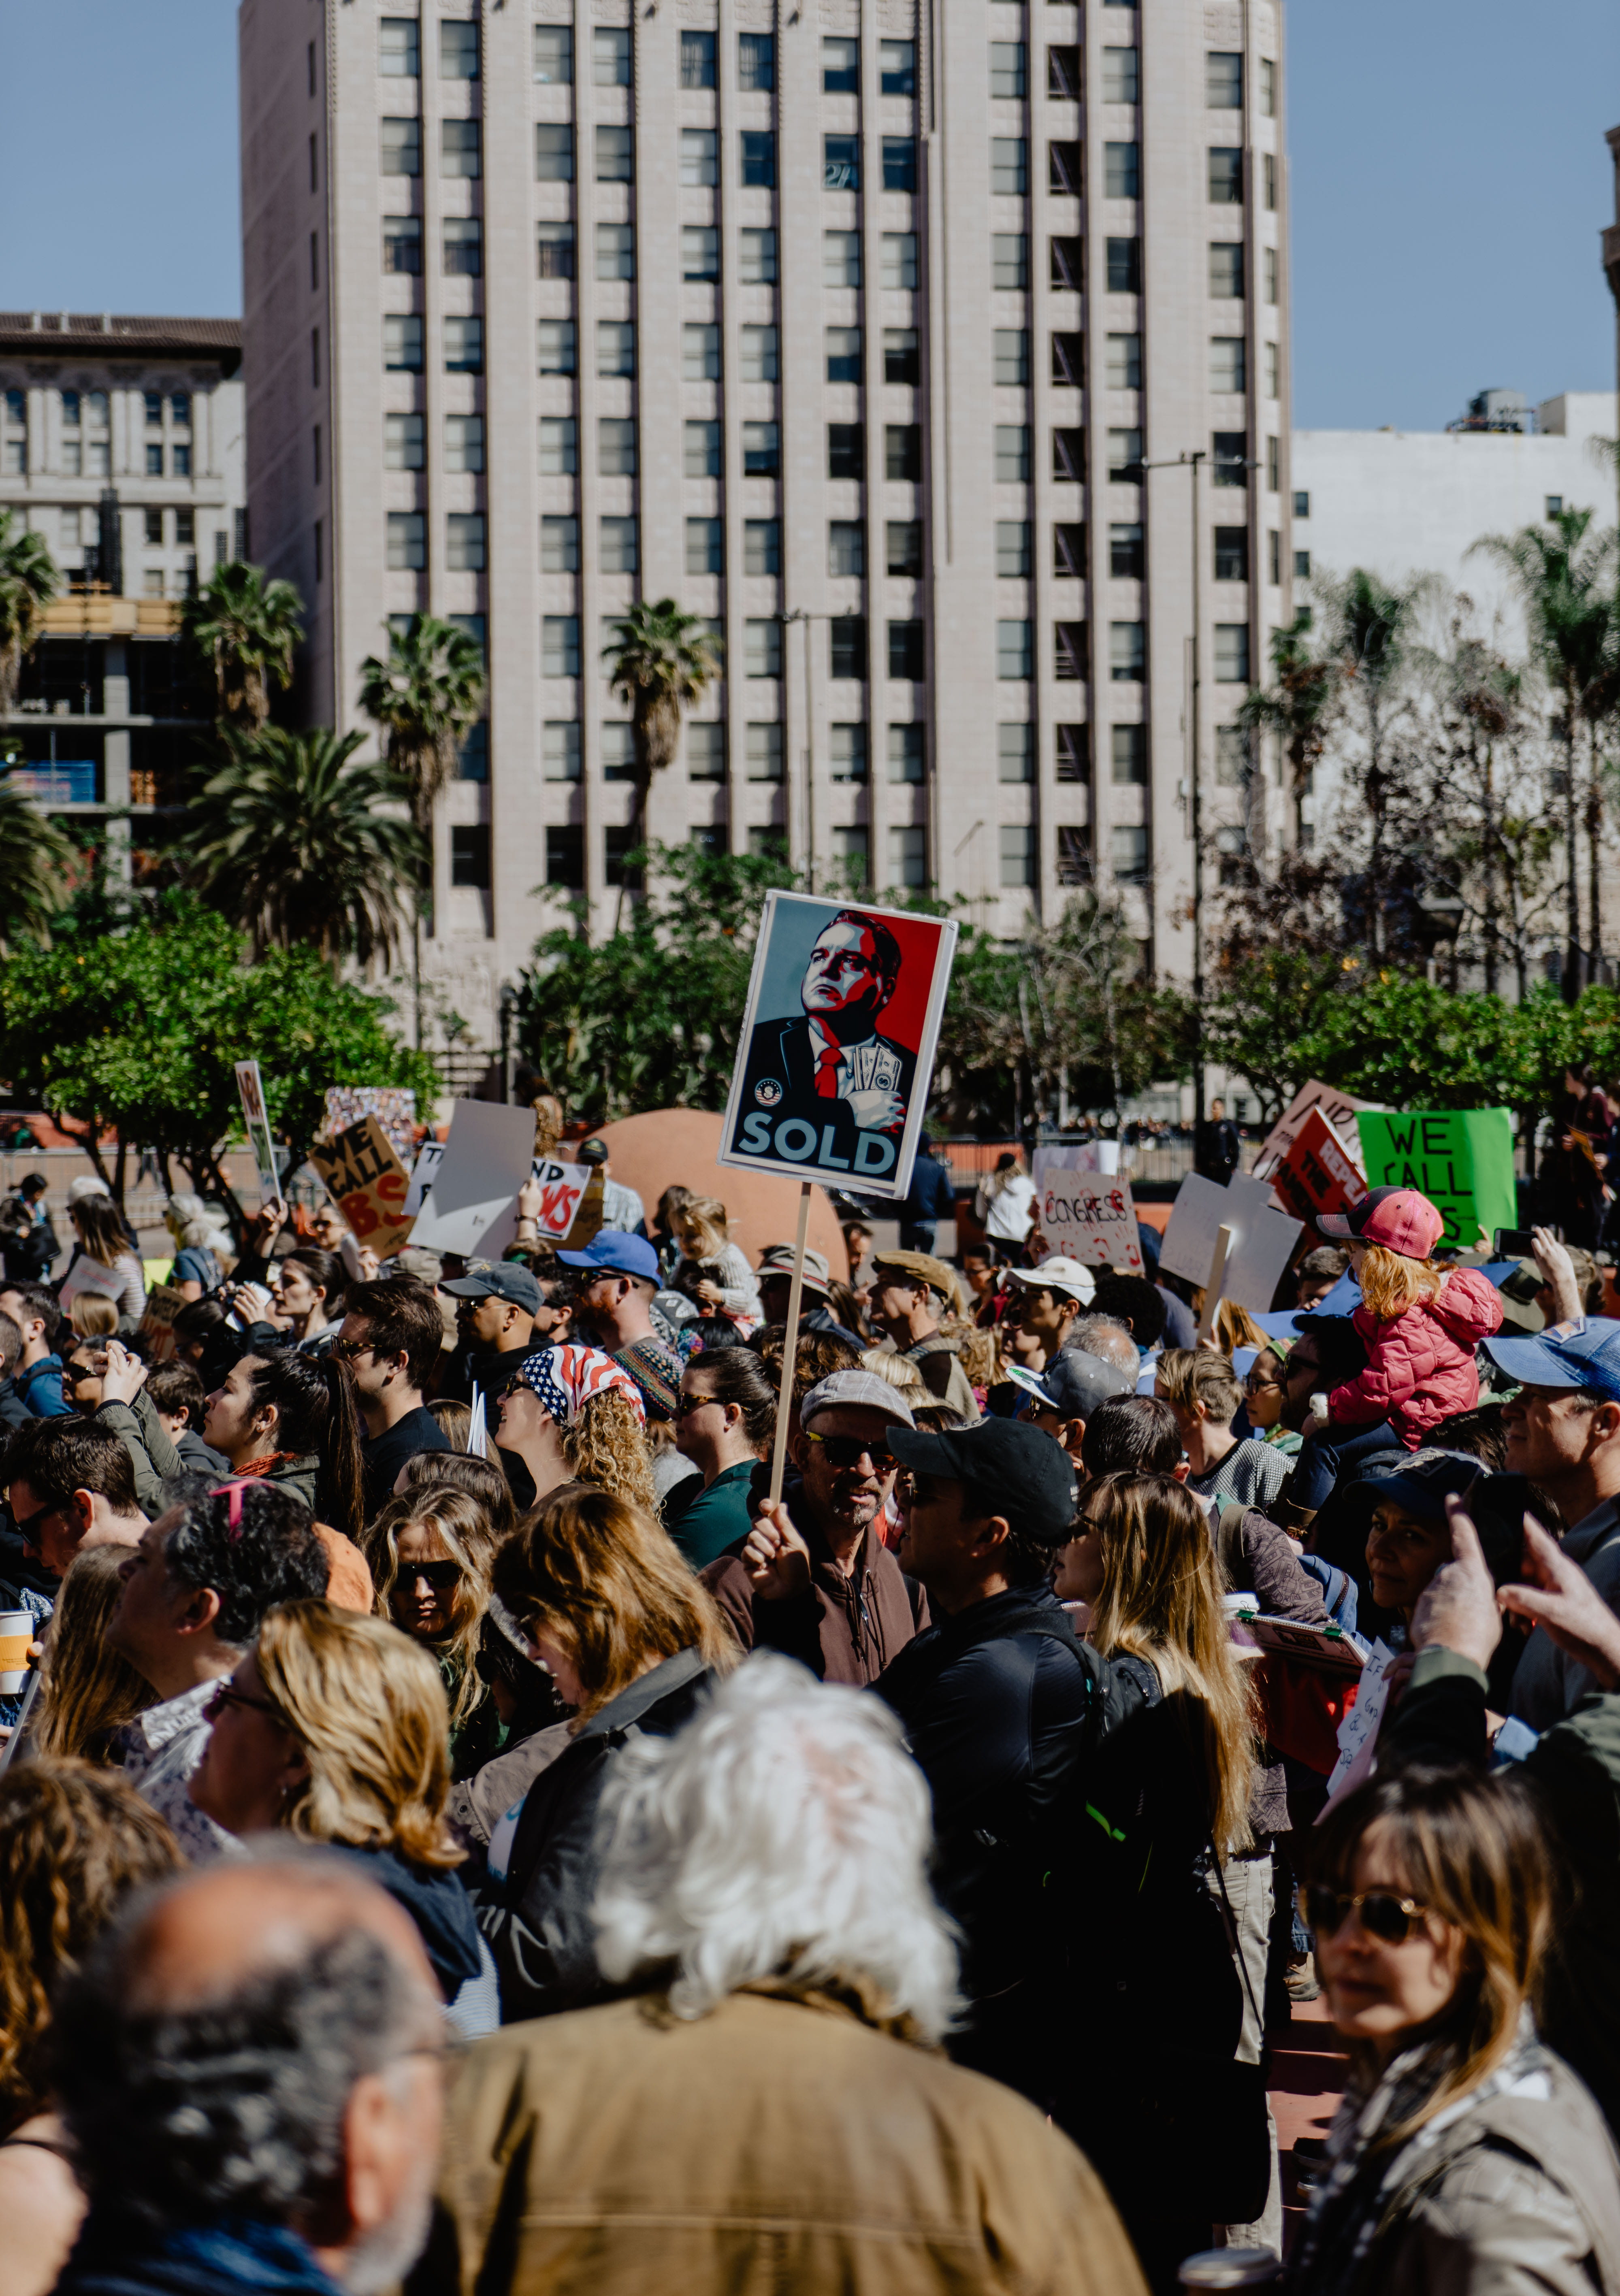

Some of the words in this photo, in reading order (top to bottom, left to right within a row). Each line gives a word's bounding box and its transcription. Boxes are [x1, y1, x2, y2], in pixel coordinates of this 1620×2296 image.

[314, 1119, 373, 1166] WE
[738, 1112, 895, 1174] SOLD
[1385, 1118, 1452, 1155] WE
[326, 1146, 393, 1200] CALL
[1383, 1161, 1473, 1196] CALL
[1045, 1195, 1127, 1224] CONGRESS
[1366, 1655, 1383, 1676] IF
